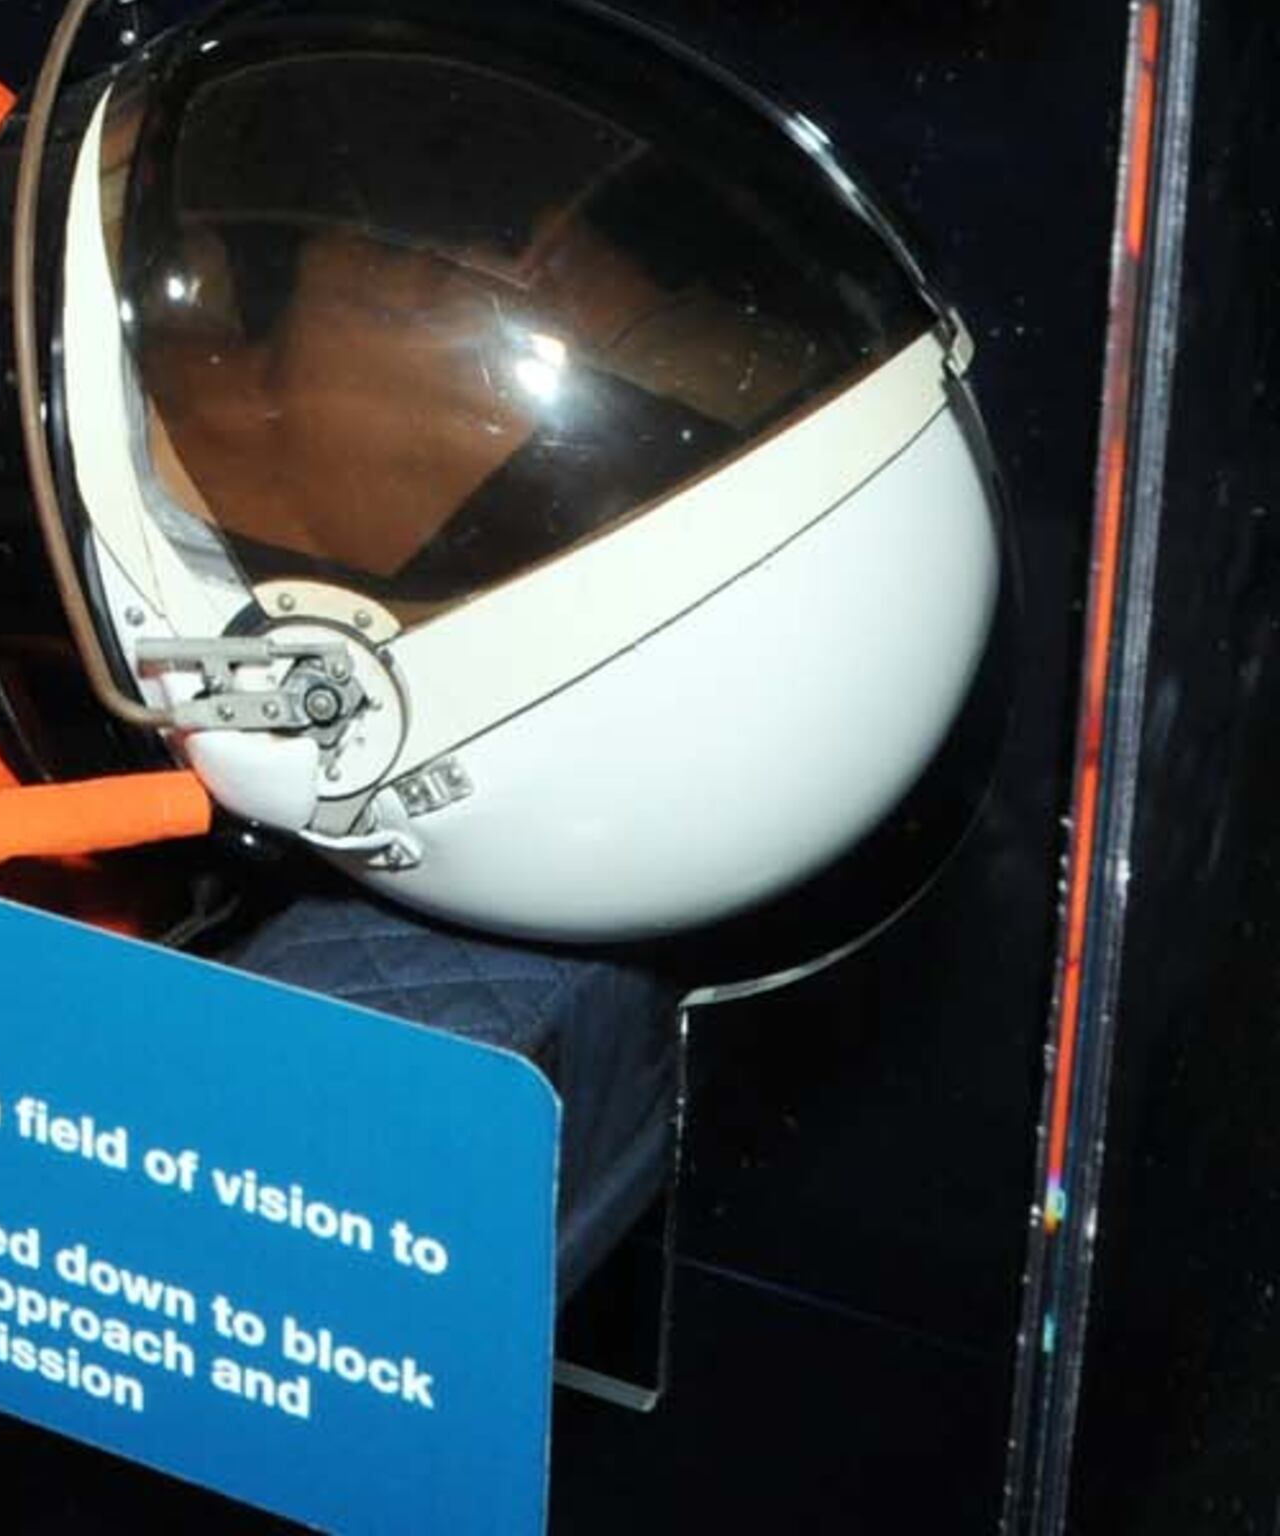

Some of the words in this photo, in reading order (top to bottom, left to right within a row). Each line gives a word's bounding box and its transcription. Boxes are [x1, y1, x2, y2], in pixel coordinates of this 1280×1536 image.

[14, 1096, 128, 1169] field
[143, 1148, 199, 1192] of
[212, 1168, 374, 1251] vision
[389, 1220, 449, 1274] to
[54, 1243, 196, 1324] down
[211, 1294, 267, 1346] to
[282, 1316, 434, 1408] block
[211, 1357, 311, 1418] and
